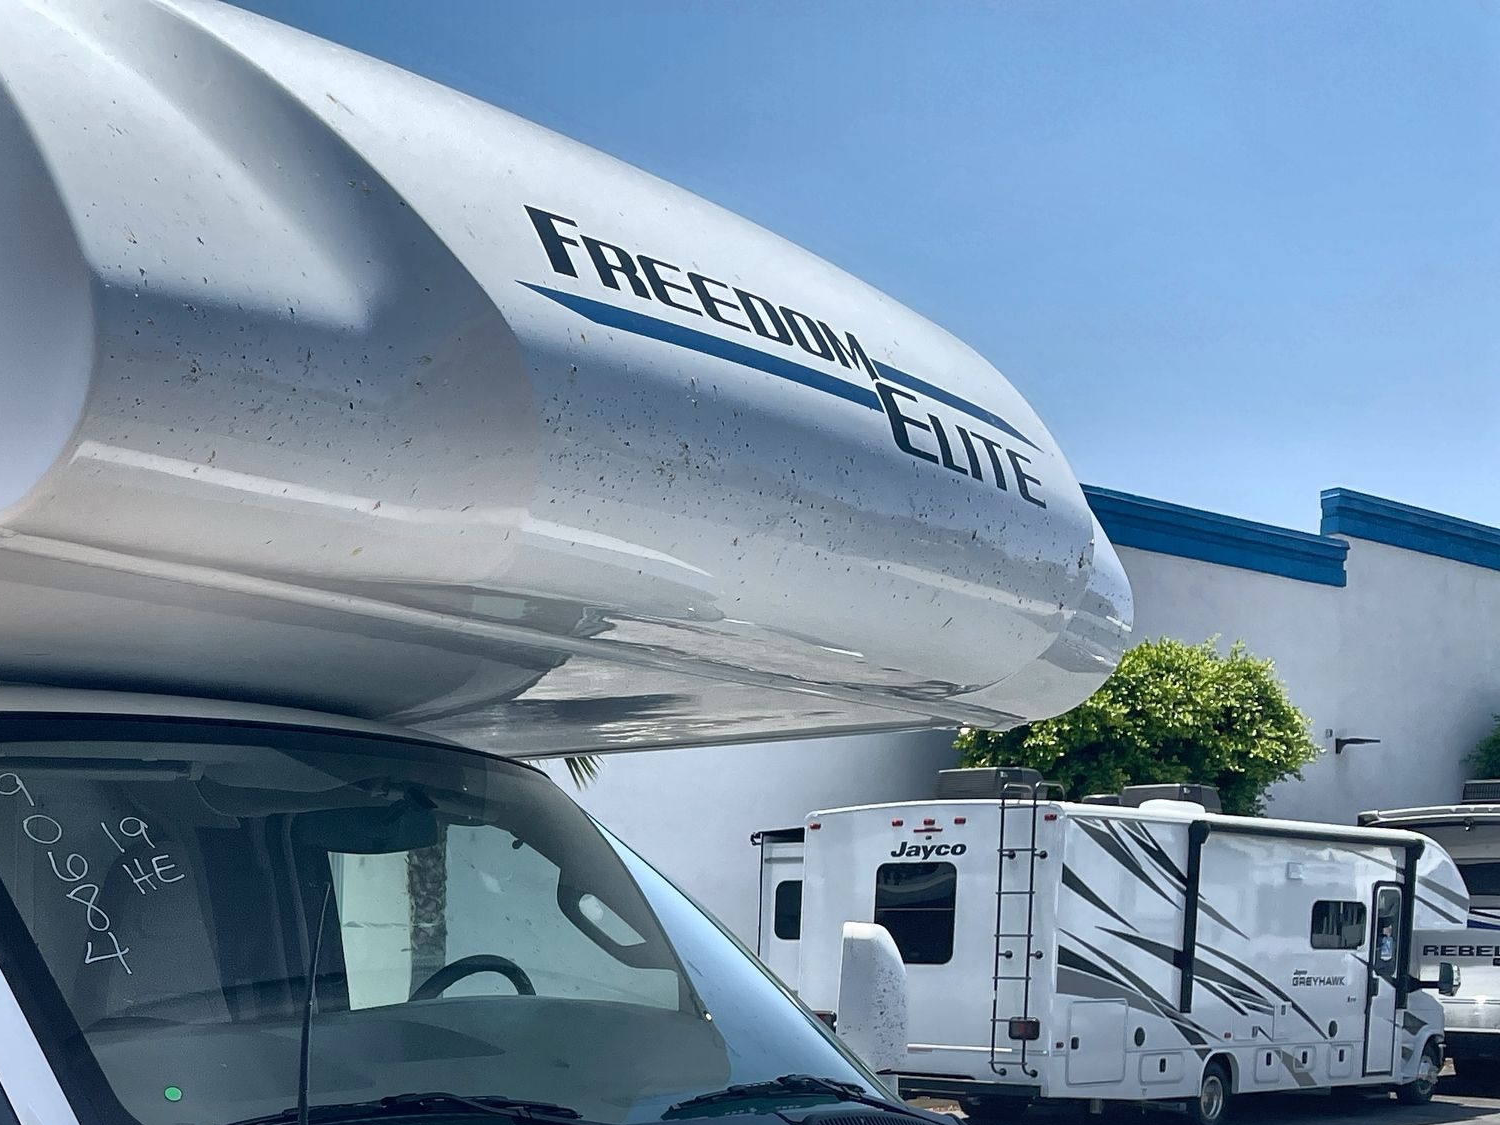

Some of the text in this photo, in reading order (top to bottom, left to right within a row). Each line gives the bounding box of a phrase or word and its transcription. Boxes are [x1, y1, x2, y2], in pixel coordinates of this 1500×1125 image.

[523, 204, 880, 381] FREEDOM
[876, 381, 1047, 509] ELITE
[101, 816, 156, 853] 19
[891, 841, 967, 860] Jayco
[122, 854, 185, 895] HE
[1292, 976, 1345, 987] GREYHAWK
